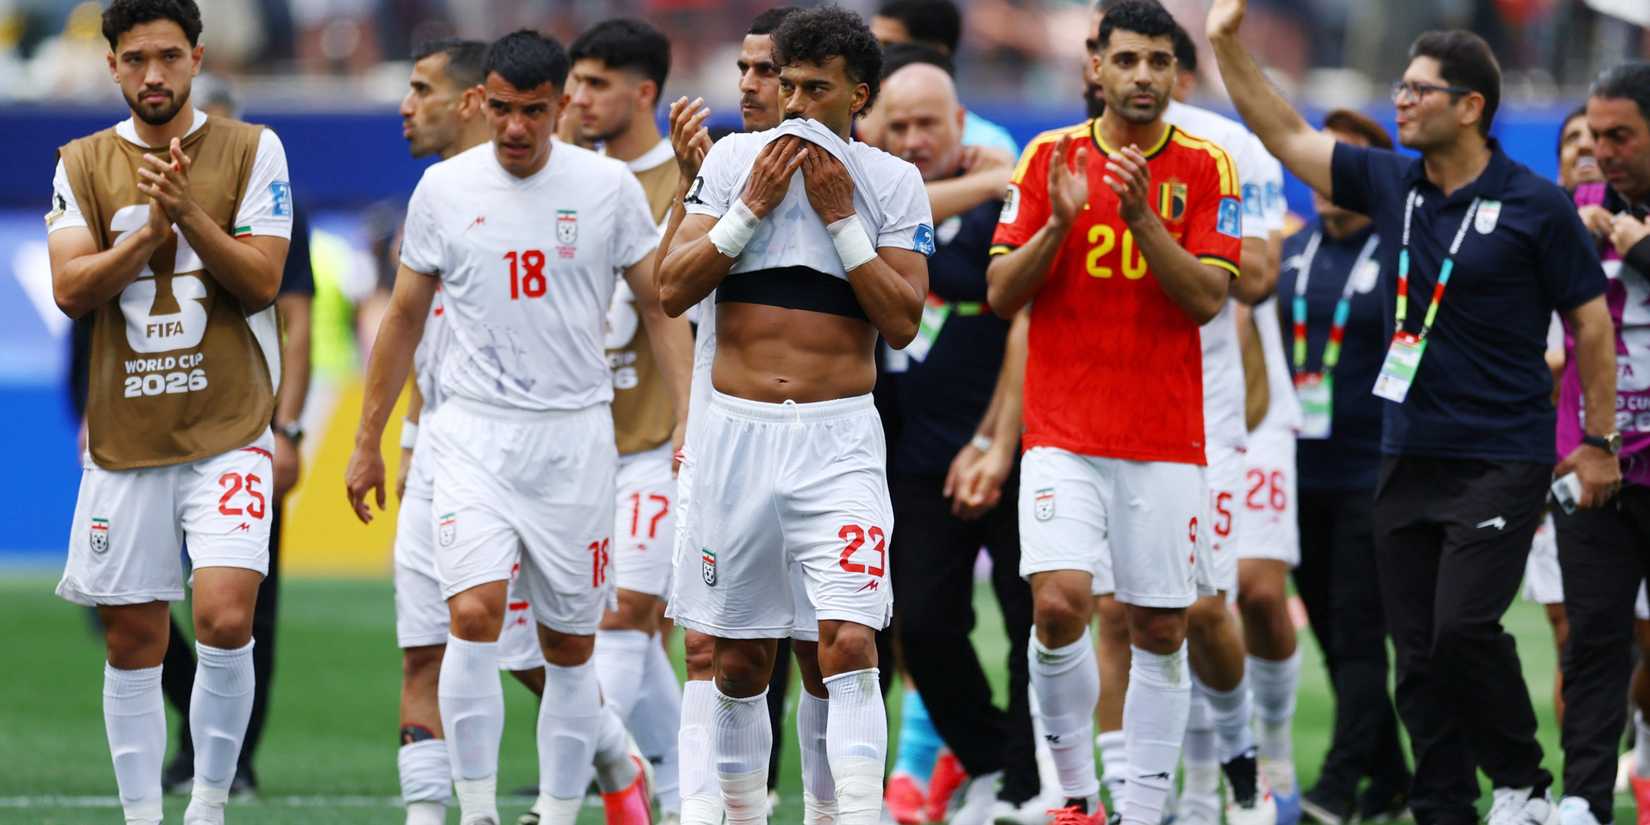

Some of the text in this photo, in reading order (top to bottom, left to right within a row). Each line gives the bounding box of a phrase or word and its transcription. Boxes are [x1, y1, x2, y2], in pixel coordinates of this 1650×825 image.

[502, 249, 547, 300] 18
[1086, 223, 1147, 279] 20
[146, 321, 184, 338] FIFA
[124, 369, 208, 398] 2026
[125, 357, 176, 374] WORLD
[1627, 394, 1650, 411] CU
[218, 472, 266, 520] 25
[1246, 467, 1287, 513] 26
[629, 491, 670, 539] 17
[838, 524, 885, 578] 23
